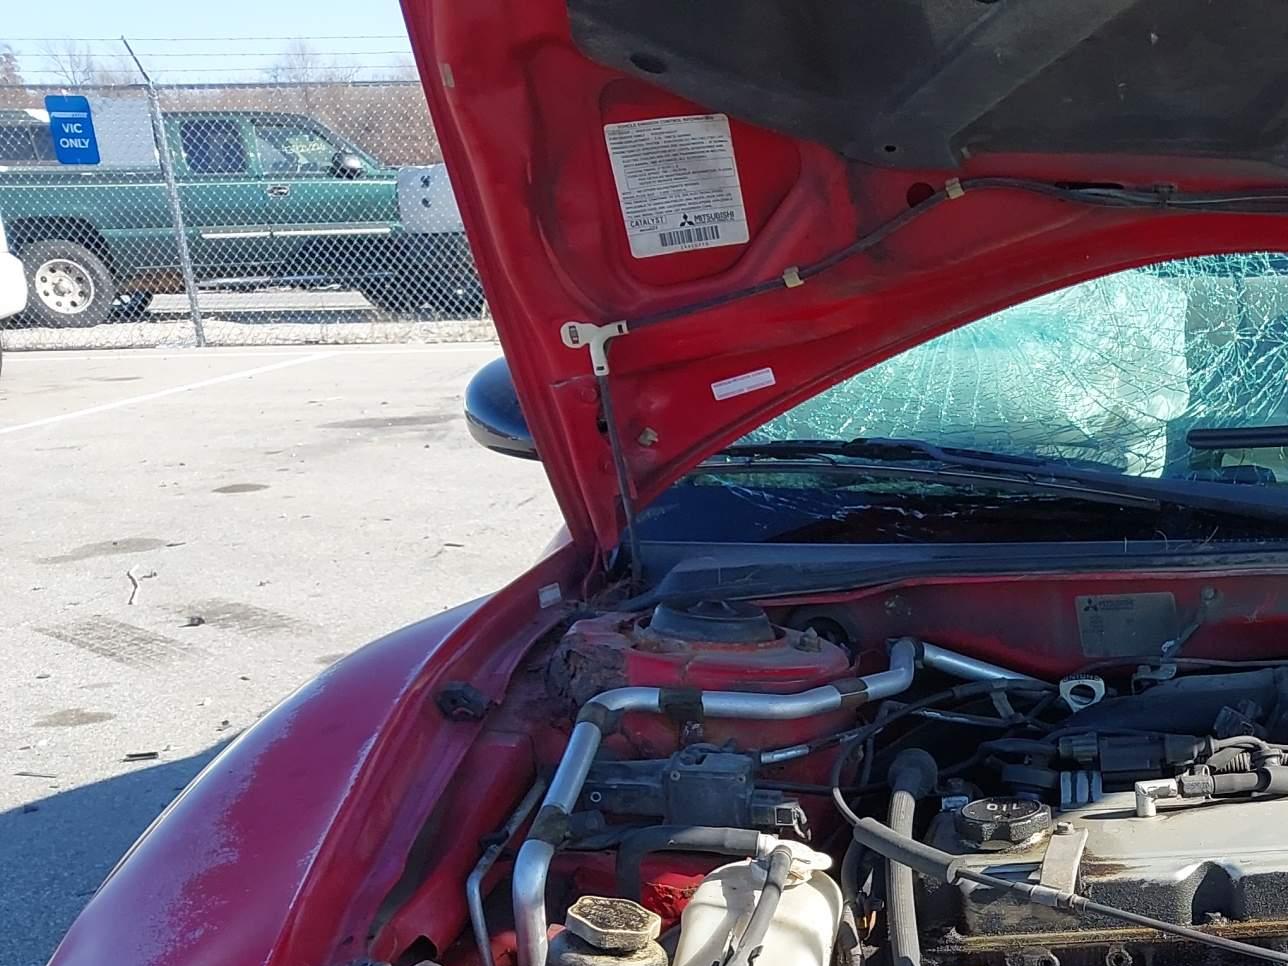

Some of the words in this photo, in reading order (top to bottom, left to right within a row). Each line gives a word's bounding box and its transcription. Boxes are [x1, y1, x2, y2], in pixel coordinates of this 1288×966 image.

[61, 123, 83, 133] VIC
[59, 137, 90, 148] ONLY
[630, 216, 665, 228] CATALYST
[693, 210, 736, 223] MITSUBISHI
[986, 803, 1021, 812] OIL
